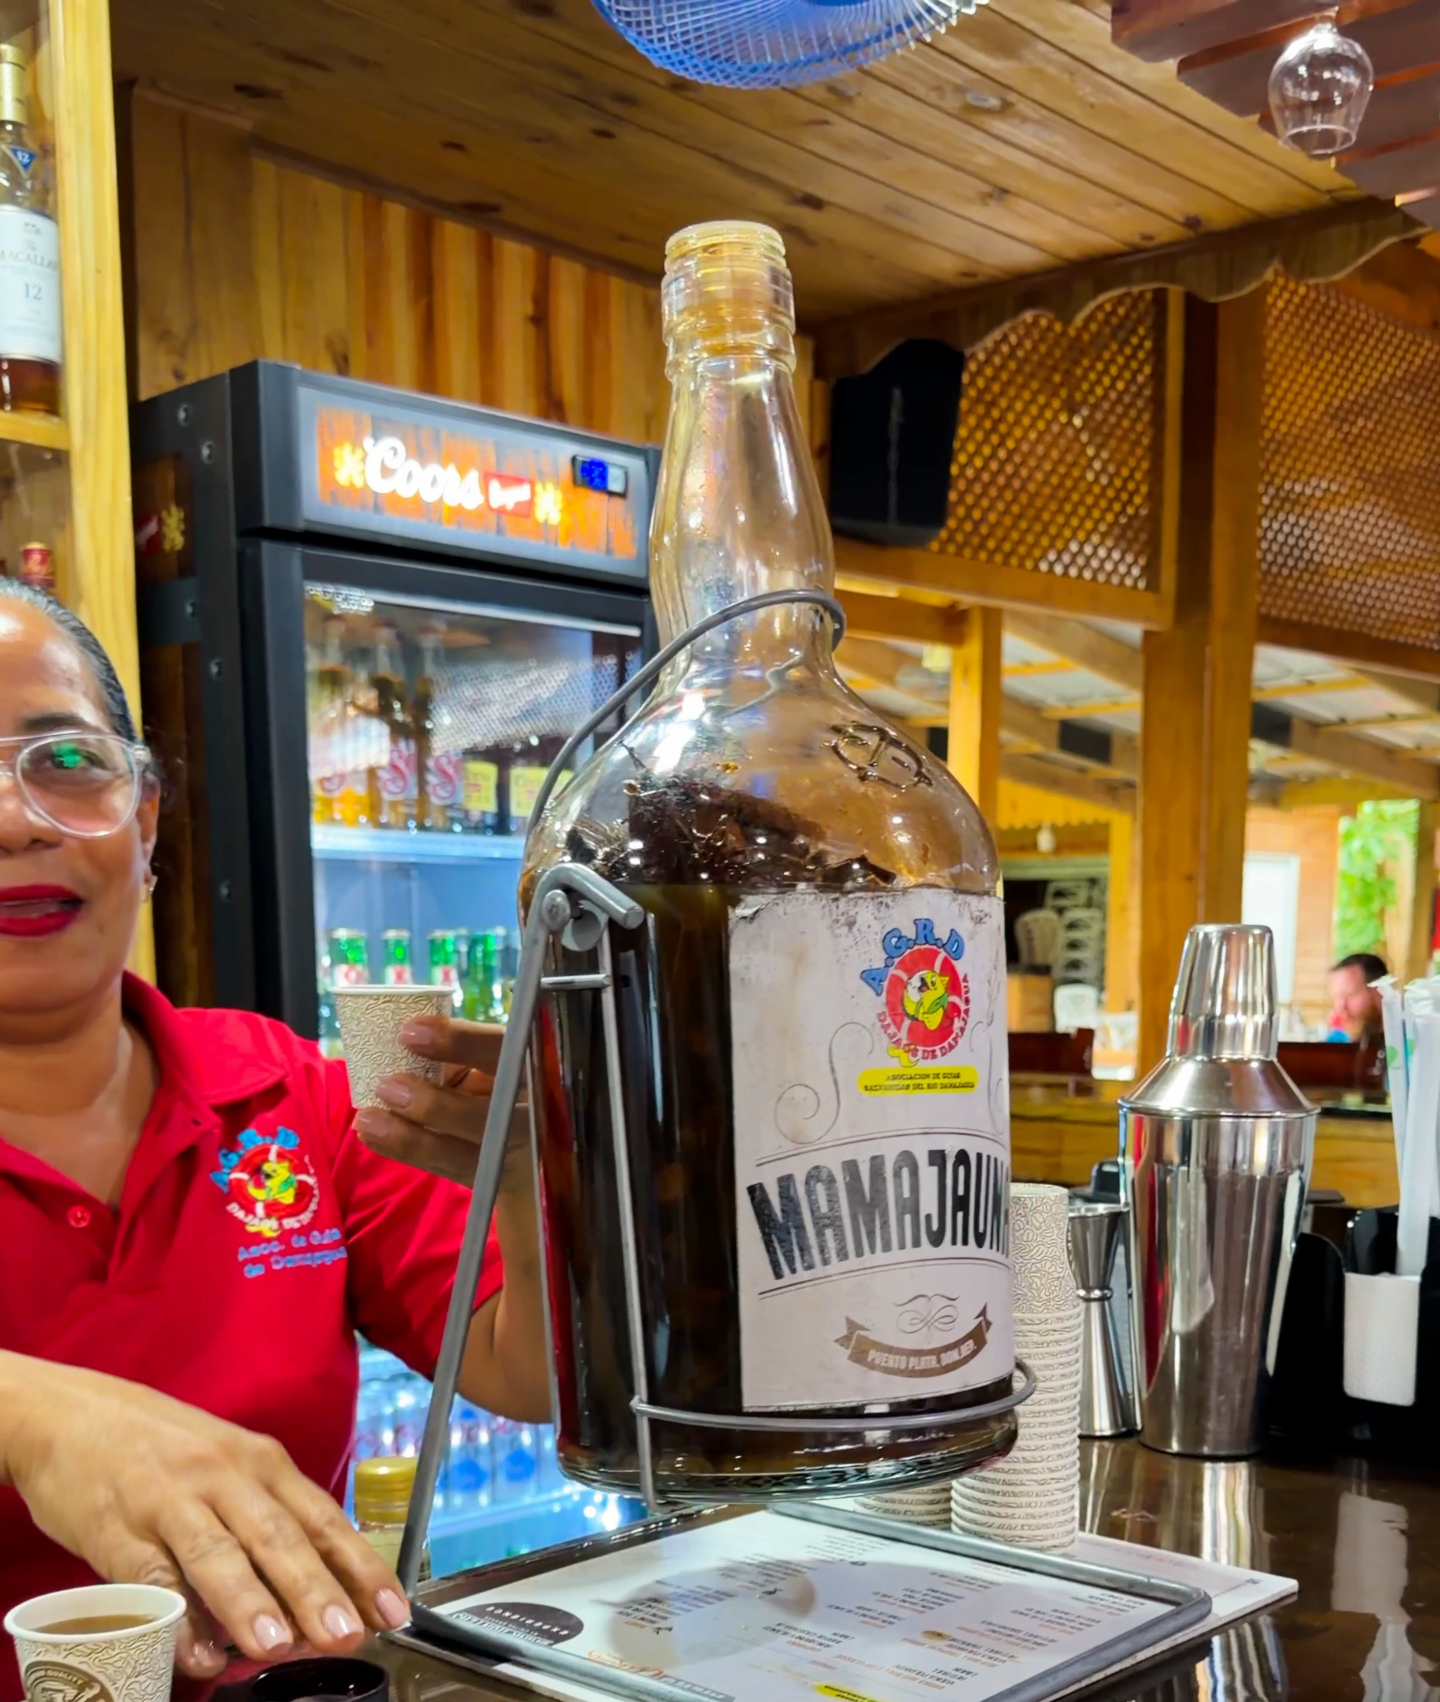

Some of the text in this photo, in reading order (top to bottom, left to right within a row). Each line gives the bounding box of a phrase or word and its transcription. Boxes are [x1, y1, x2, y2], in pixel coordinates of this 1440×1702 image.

[23, 282, 43, 301] 12
[363, 436, 484, 510] Coors
[921, 1048, 939, 1060] DE
[867, 1349, 907, 1369] PUERTO
[46, 1669, 84, 1685] QUALITY
